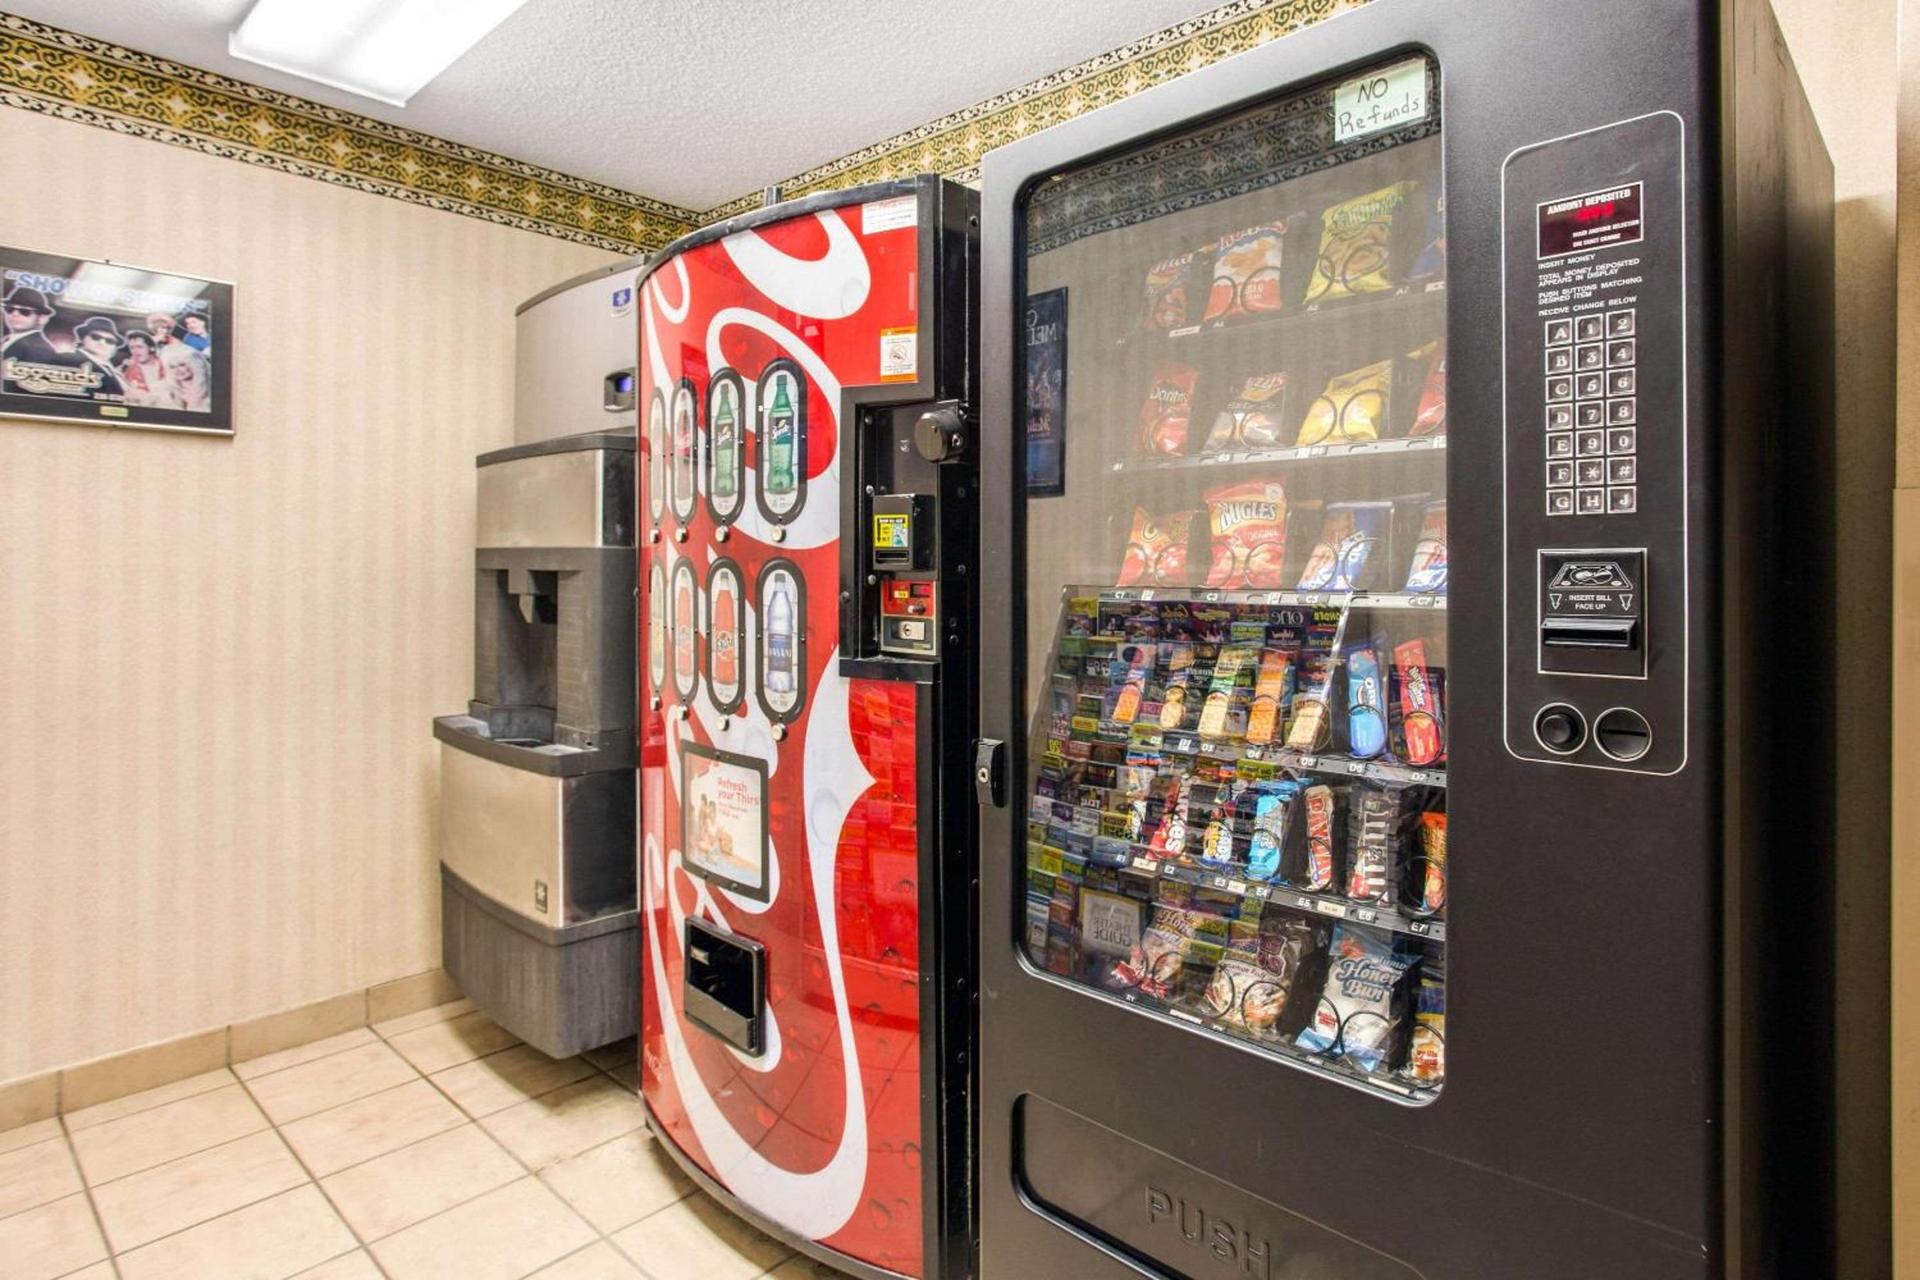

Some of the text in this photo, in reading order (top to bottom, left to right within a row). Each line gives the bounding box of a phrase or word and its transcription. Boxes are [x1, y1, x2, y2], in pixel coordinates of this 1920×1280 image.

[1357, 78, 1389, 103] NO
[1338, 92, 1420, 135] Refunds
[1547, 199, 1584, 215] AMOUNT
[1585, 189, 1631, 206] DEPOSITED
[1538, 253, 1596, 269] INSERT MONEY
[1538, 258, 1640, 281] TOTAL MONEY DEPOSITED
[1538, 276, 1573, 287] APPEARS
[1587, 268, 1619, 280] DISPLAY
[1538, 276, 1643, 299] PUSH BUTTONS MATCHING
[1538, 291, 1593, 305] DESIRED ITEM
[1538, 295, 1638, 317] RECEIVE CHANGE BELOW
[1586, 323, 1594, 335] 1
[1617, 318, 1628, 330] 2
[1554, 326, 1567, 339] A
[1586, 351, 1597, 363] 3
[1616, 347, 1627, 359] 4
[1556, 355, 1568, 367] B
[1555, 382, 1568, 395] C
[1586, 379, 1597, 392] 5
[1617, 377, 1628, 388] 6
[1150, 386, 1189, 403] Doritos
[1557, 412, 1569, 423] D
[1586, 409, 1597, 420] 7
[1618, 406, 1629, 418] 8
[1556, 440, 1569, 452] E
[1587, 437, 1598, 449] 9
[1618, 435, 1629, 447] 0
[1557, 468, 1569, 480] F
[1618, 465, 1632, 477] #
[1555, 496, 1569, 508] G
[1586, 495, 1599, 507] H
[1619, 493, 1630, 506] J
[1568, 594, 1612, 602] INSERT BILL
[1575, 602, 1594, 610] FACE
[1412, 772, 1428, 781] D7
[717, 776, 748, 792] Refresh
[1358, 911, 1372, 921] E6
[1411, 923, 1428, 934] E7
[1337, 957, 1403, 985] Honey
[1343, 977, 1388, 1002] Bun
[1145, 1185, 1272, 1280] PUSH
